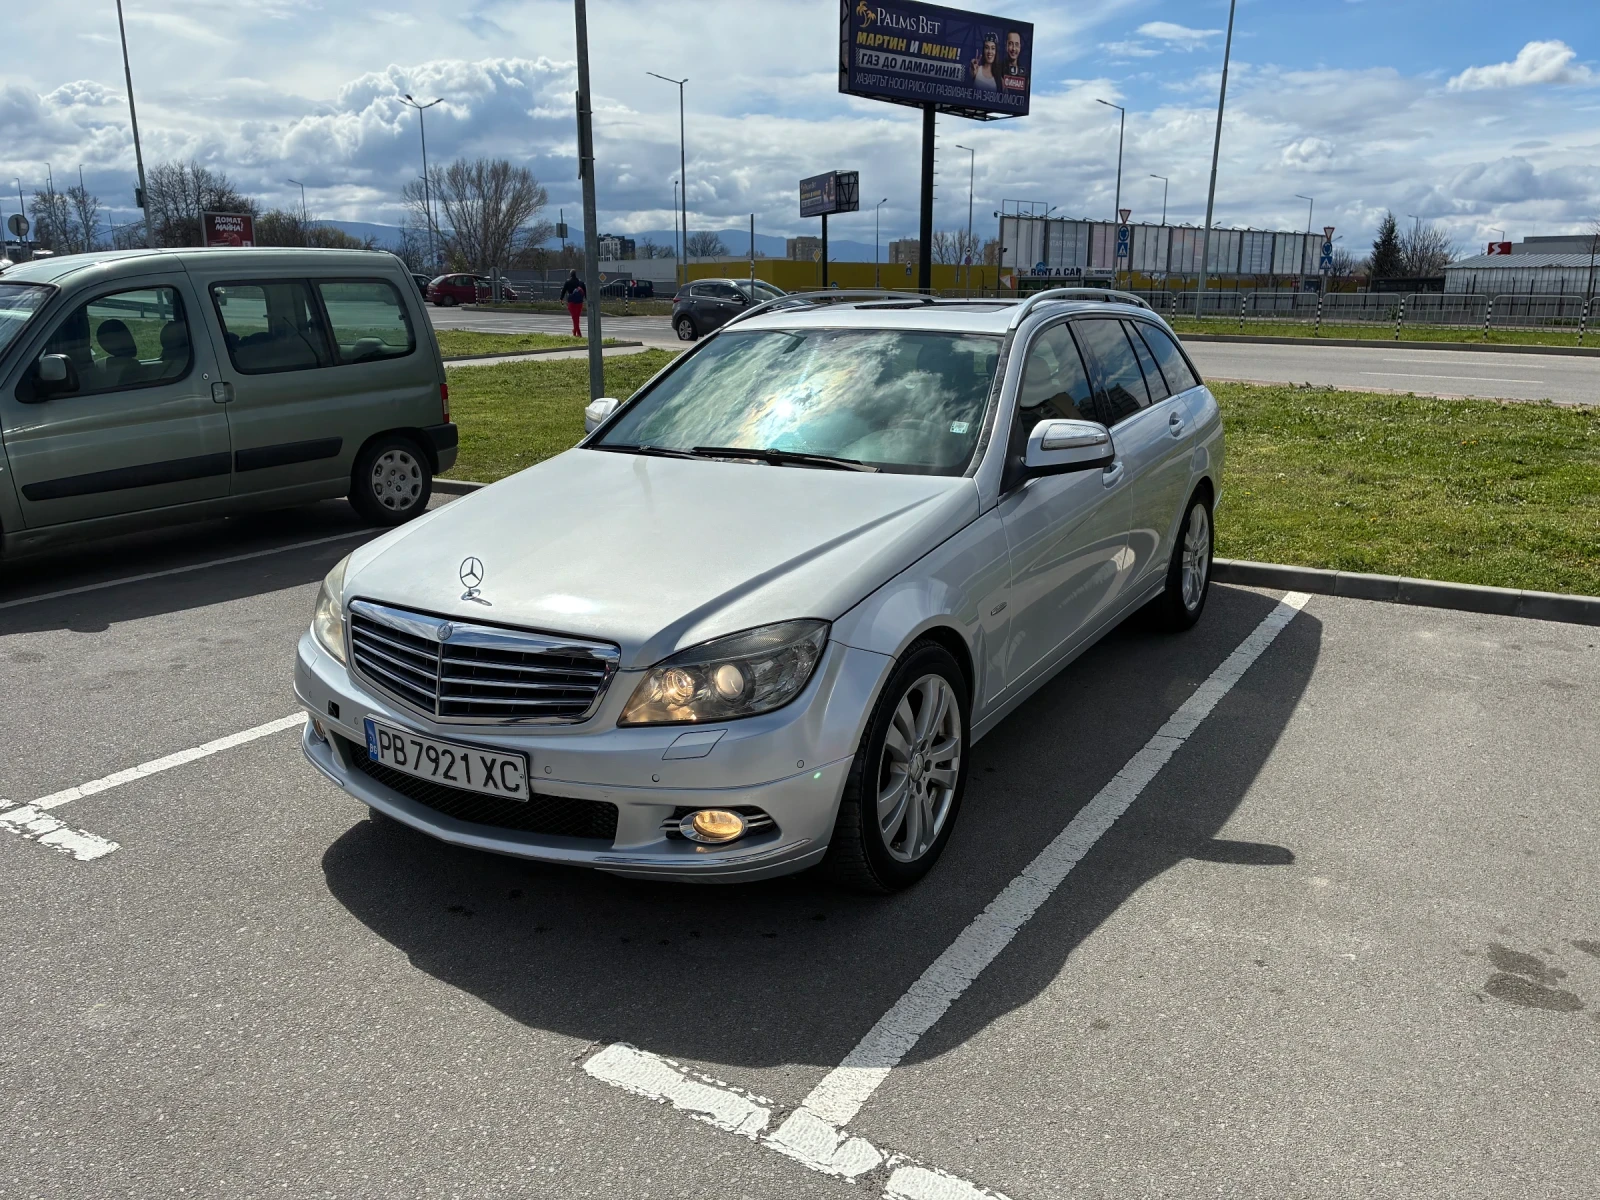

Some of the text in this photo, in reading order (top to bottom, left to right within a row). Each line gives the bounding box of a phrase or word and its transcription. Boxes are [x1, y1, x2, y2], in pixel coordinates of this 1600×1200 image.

[856, 31, 961, 60] МАРТИН И МИНИ!
[861, 53, 960, 79] ГАЗ ДО ЛАМАРИНИ!
[855, 72, 889, 87] ХАЗАРТЪТ
[889, 77, 909, 90] НОСИ
[909, 80, 927, 93] РИСК
[927, 82, 936, 93] ОТ
[936, 84, 973, 99] РАЗВИВАНЕ
[973, 89, 983, 100] НА
[1055, 268, 1061, 276] A
[1063, 267, 1082, 276] CAR
[369, 743, 378, 755] BG
[410, 740, 471, 785] 7921
